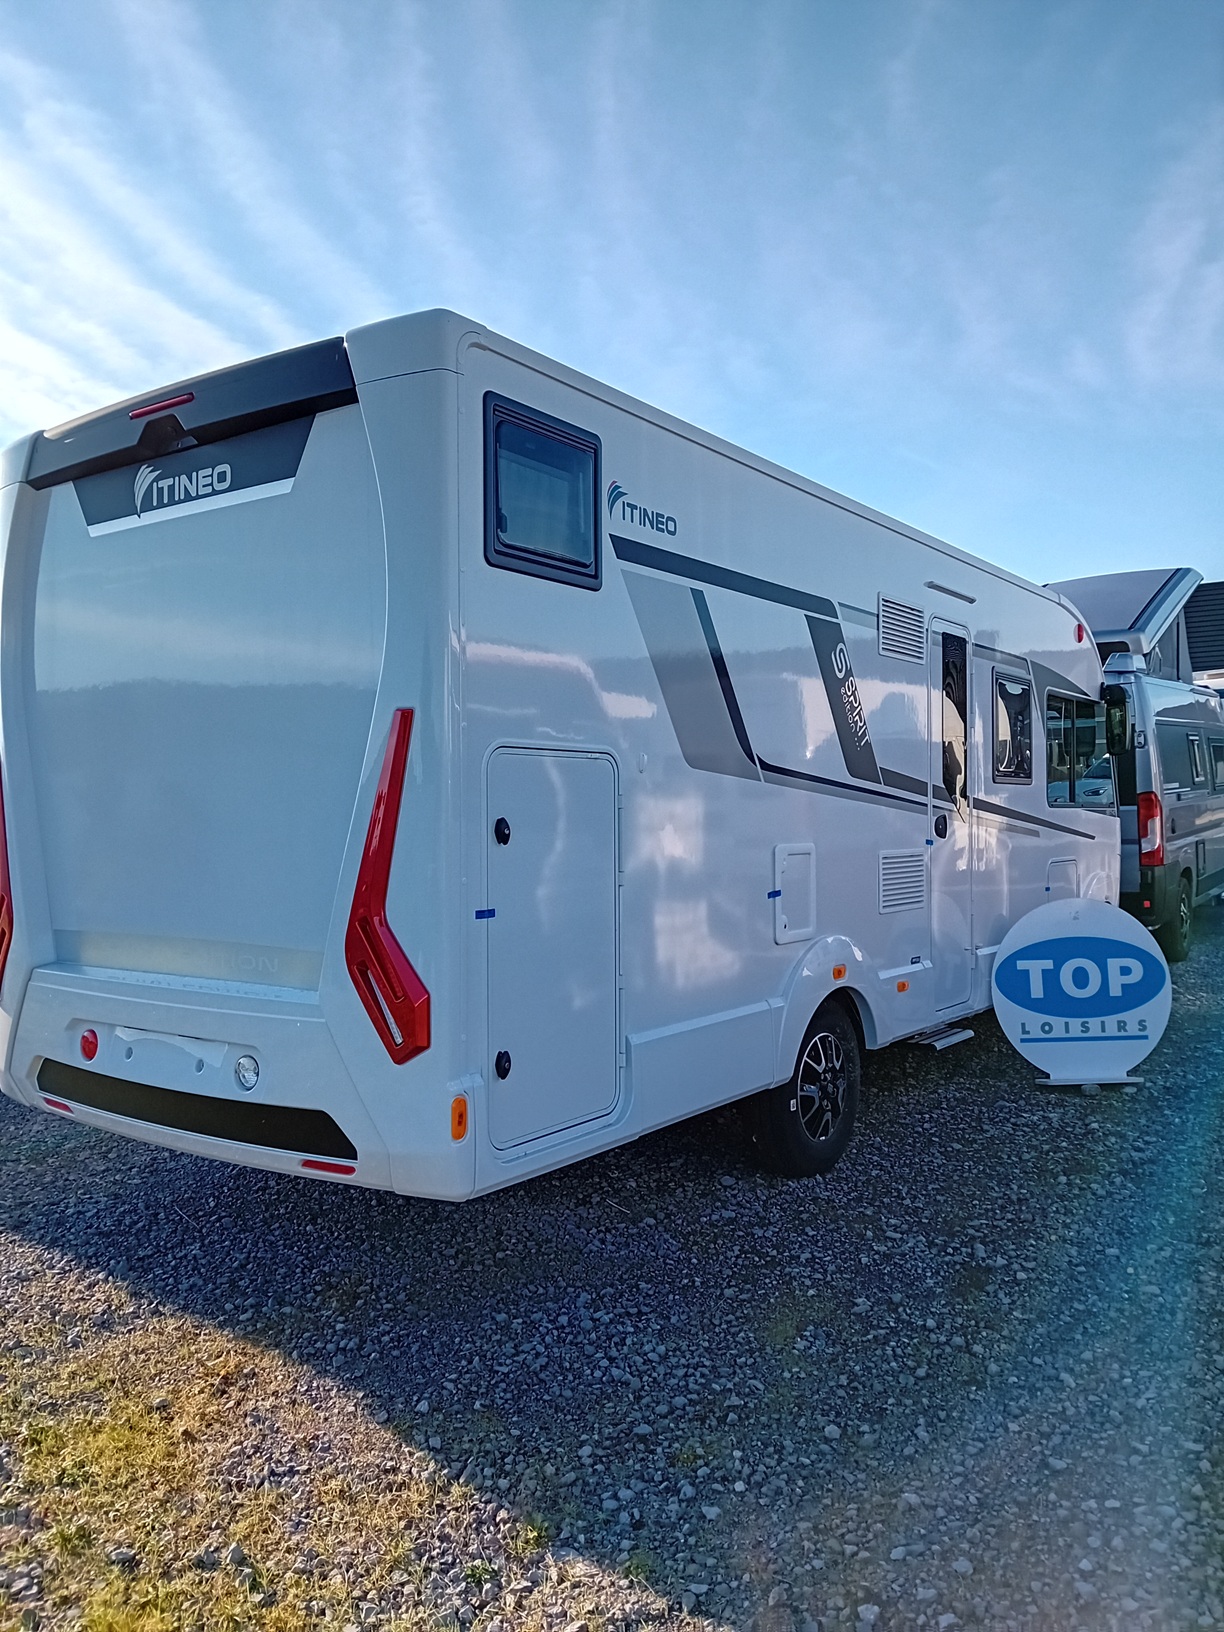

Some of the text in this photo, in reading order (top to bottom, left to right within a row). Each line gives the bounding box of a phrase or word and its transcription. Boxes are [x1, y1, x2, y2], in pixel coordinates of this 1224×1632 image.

[152, 463, 232, 507] ITINEO
[622, 500, 677, 537] ITINEO
[840, 686, 856, 733] edition
[845, 676, 871, 747] SPIRIT
[1016, 957, 1144, 999] TOP
[1020, 1018, 1148, 1036] LOISIRS
